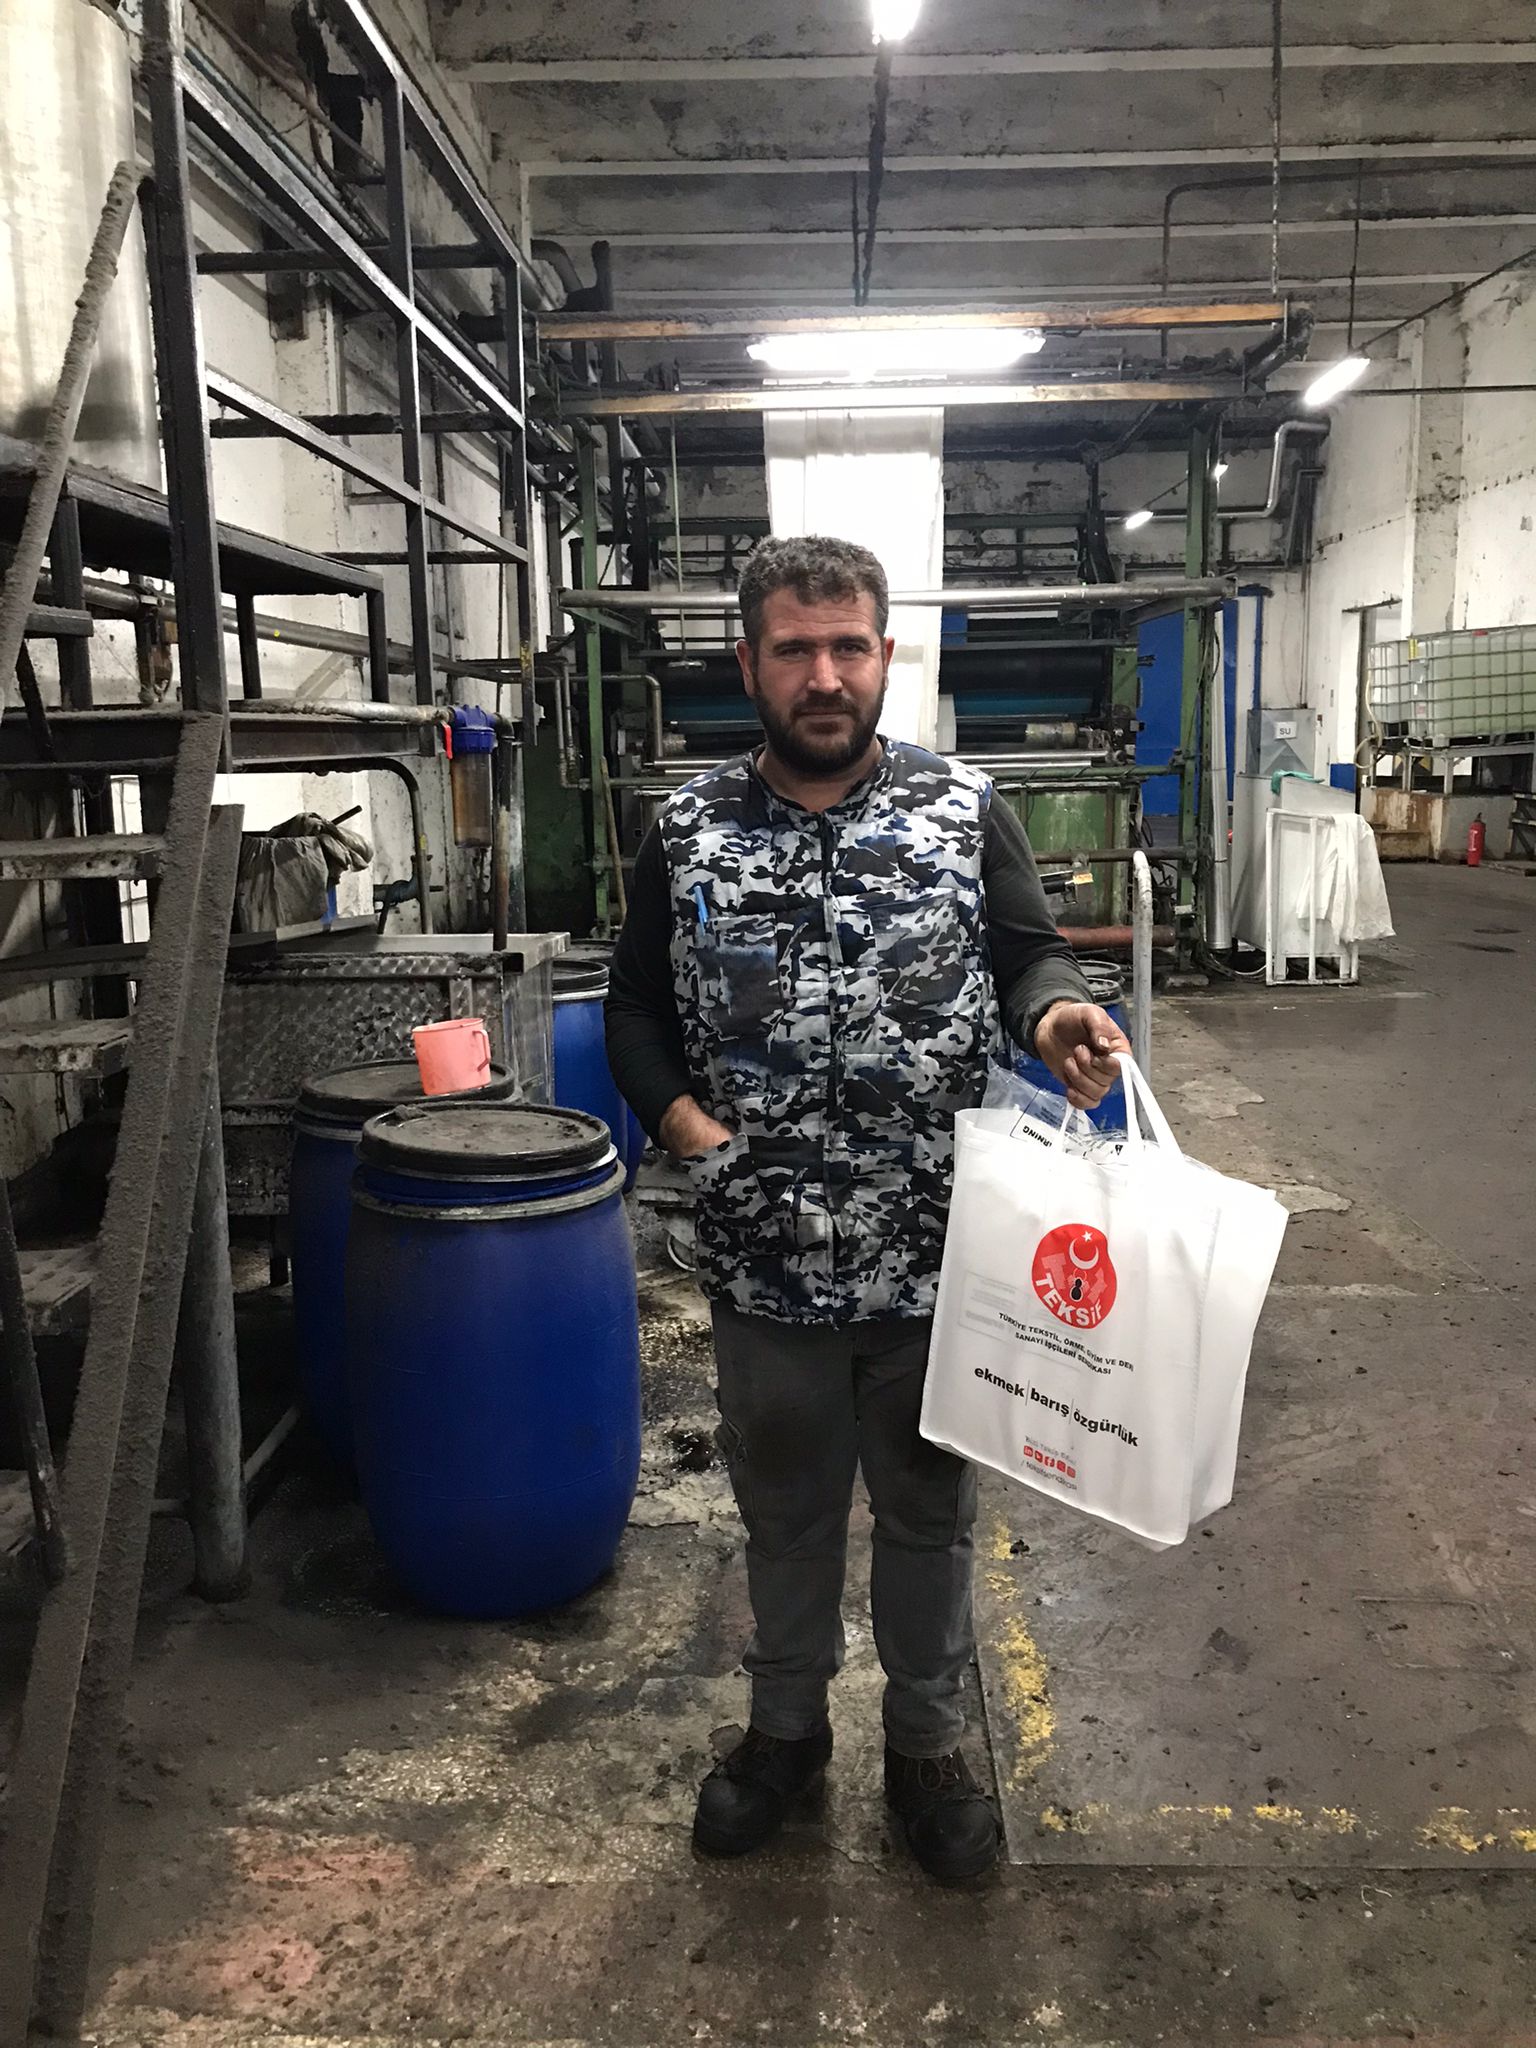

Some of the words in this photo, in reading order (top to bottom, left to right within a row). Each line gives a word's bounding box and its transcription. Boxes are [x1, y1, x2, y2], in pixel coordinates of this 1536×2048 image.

[1279, 727, 1291, 735] SU
[1022, 1125, 1053, 1148] RNING
[1105, 1358, 1117, 1366] VE
[974, 1367, 1025, 1398] ekmek
[1030, 1388, 1070, 1417] barış
[1073, 1408, 1138, 1447] özgürlük
